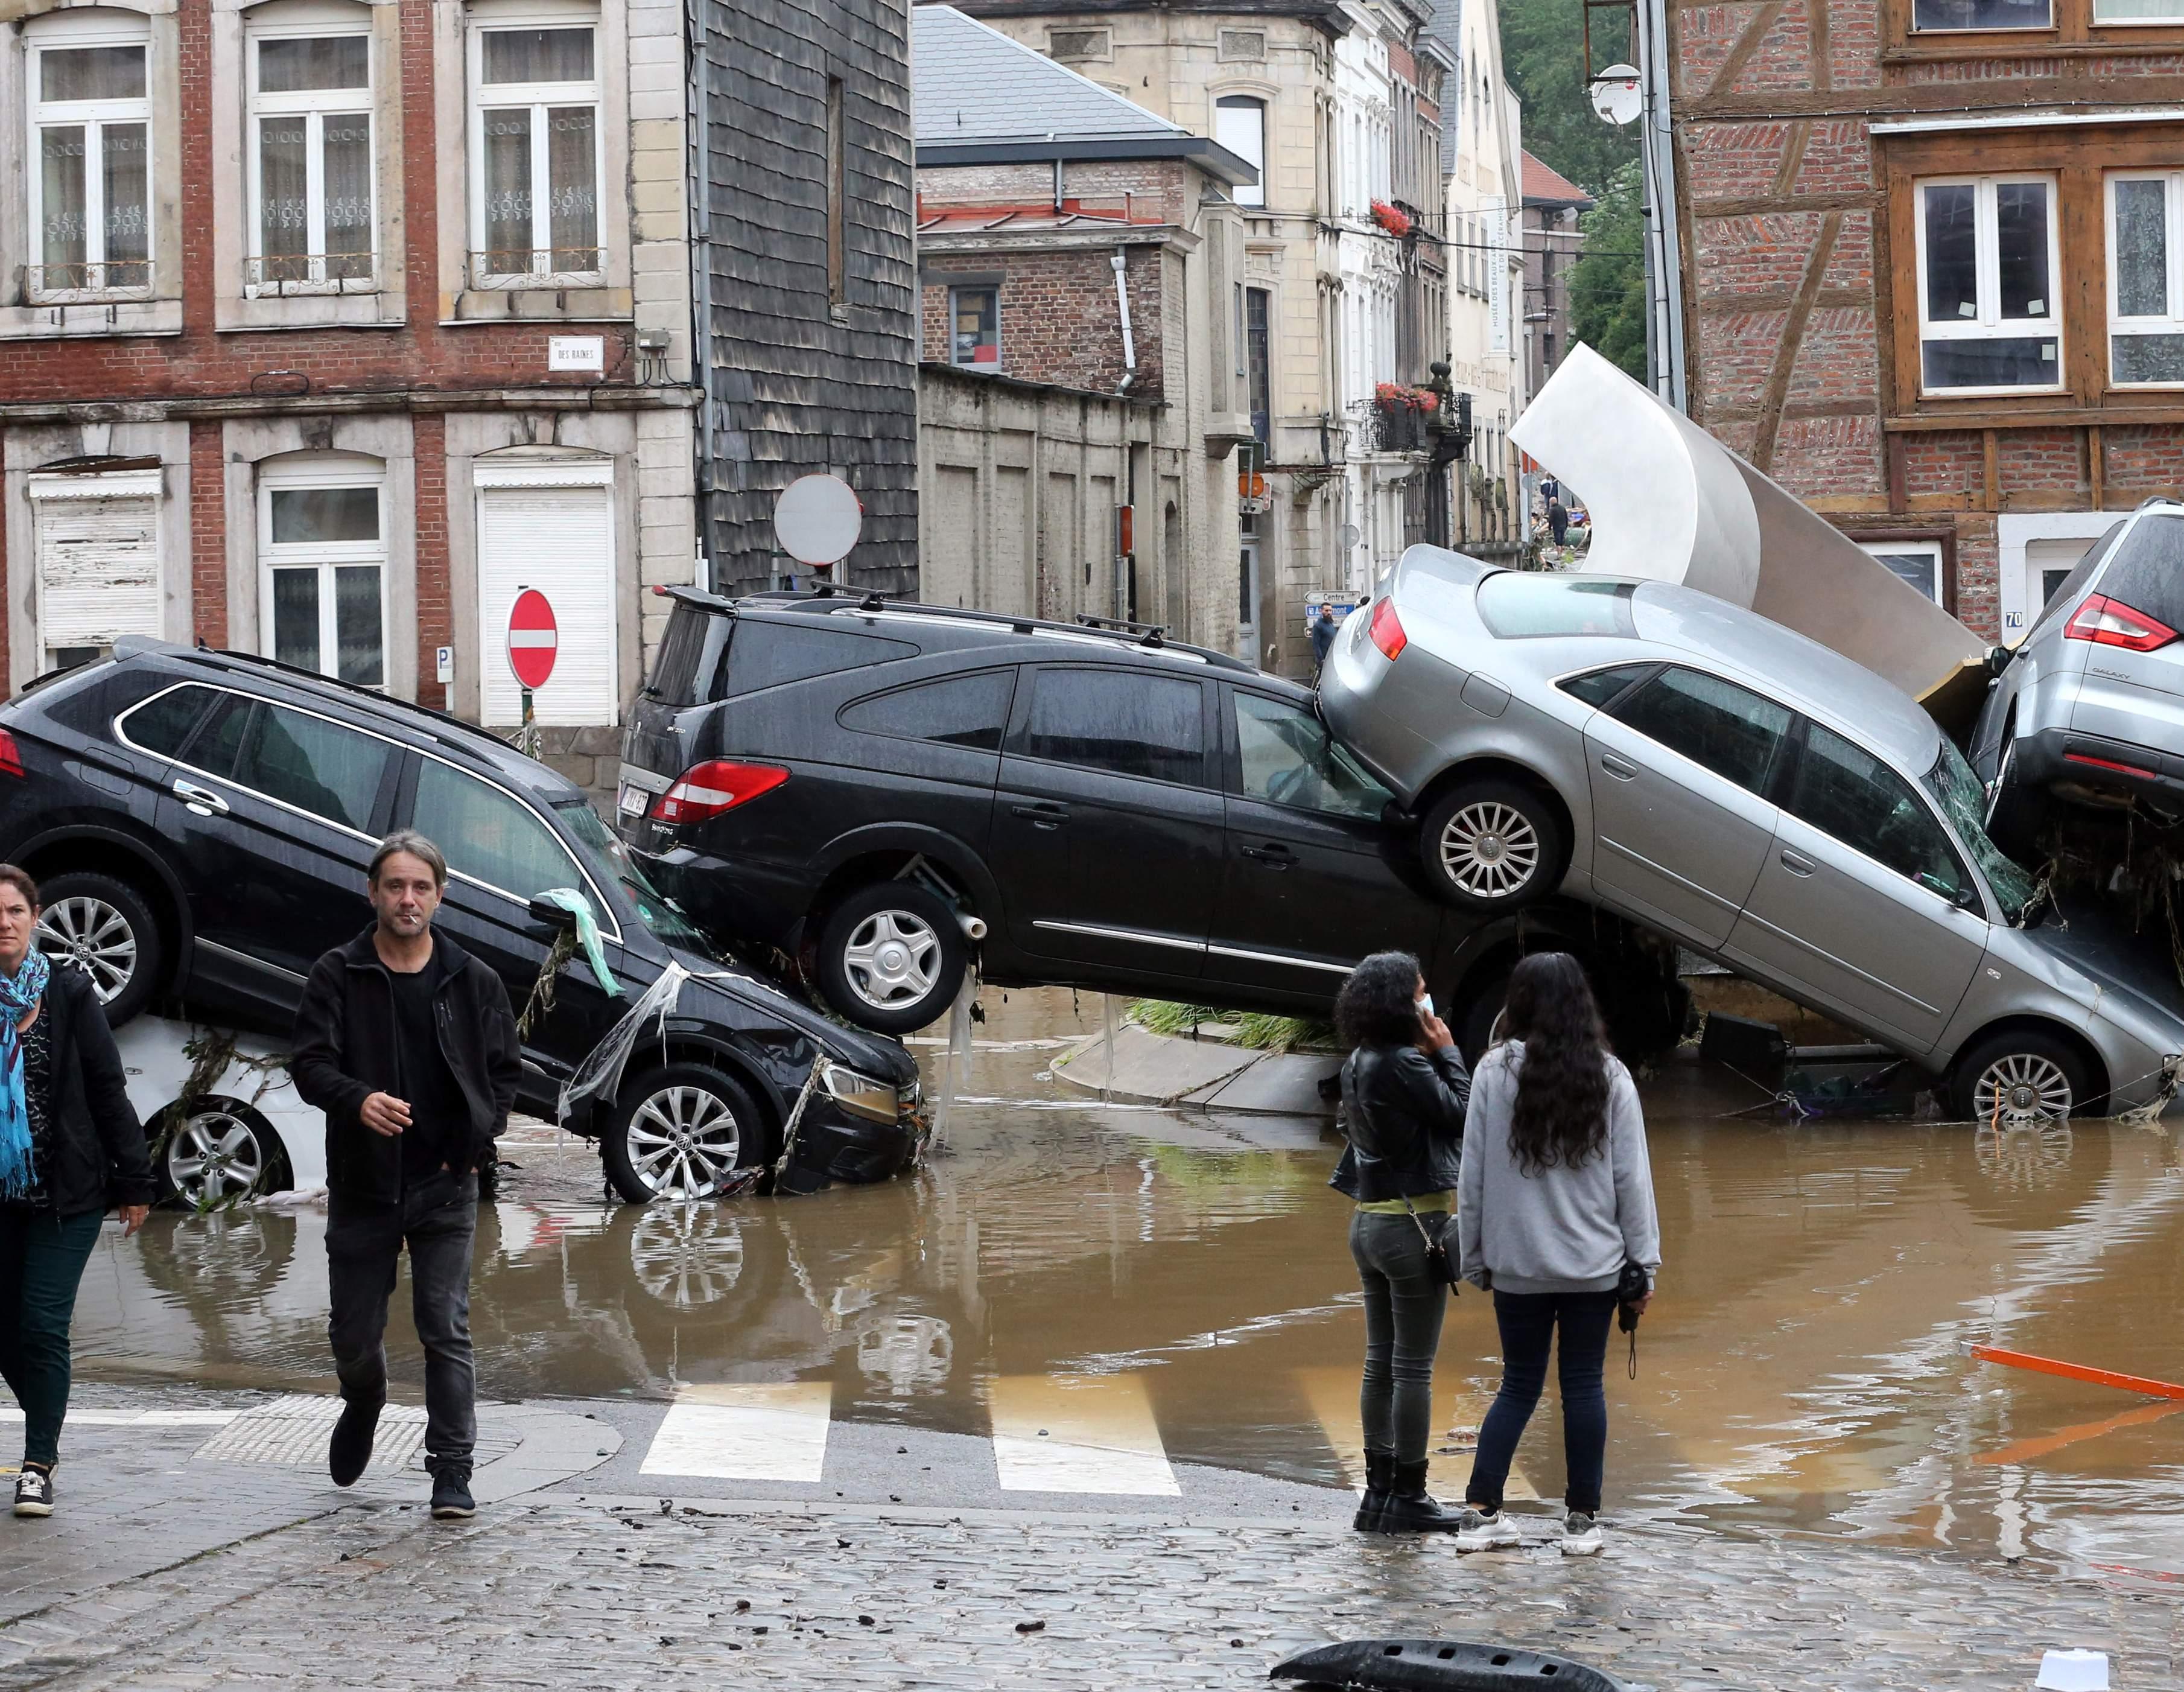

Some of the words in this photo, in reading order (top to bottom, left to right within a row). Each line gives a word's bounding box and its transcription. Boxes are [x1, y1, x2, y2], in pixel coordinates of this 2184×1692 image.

[1499, 253, 1505, 262] DE
[1499, 265, 1505, 273] ET
[559, 350, 569, 359] DES
[2007, 612, 2022, 626] 70
[439, 649, 448, 669] P
[2092, 667, 2131, 679] GALAXY
